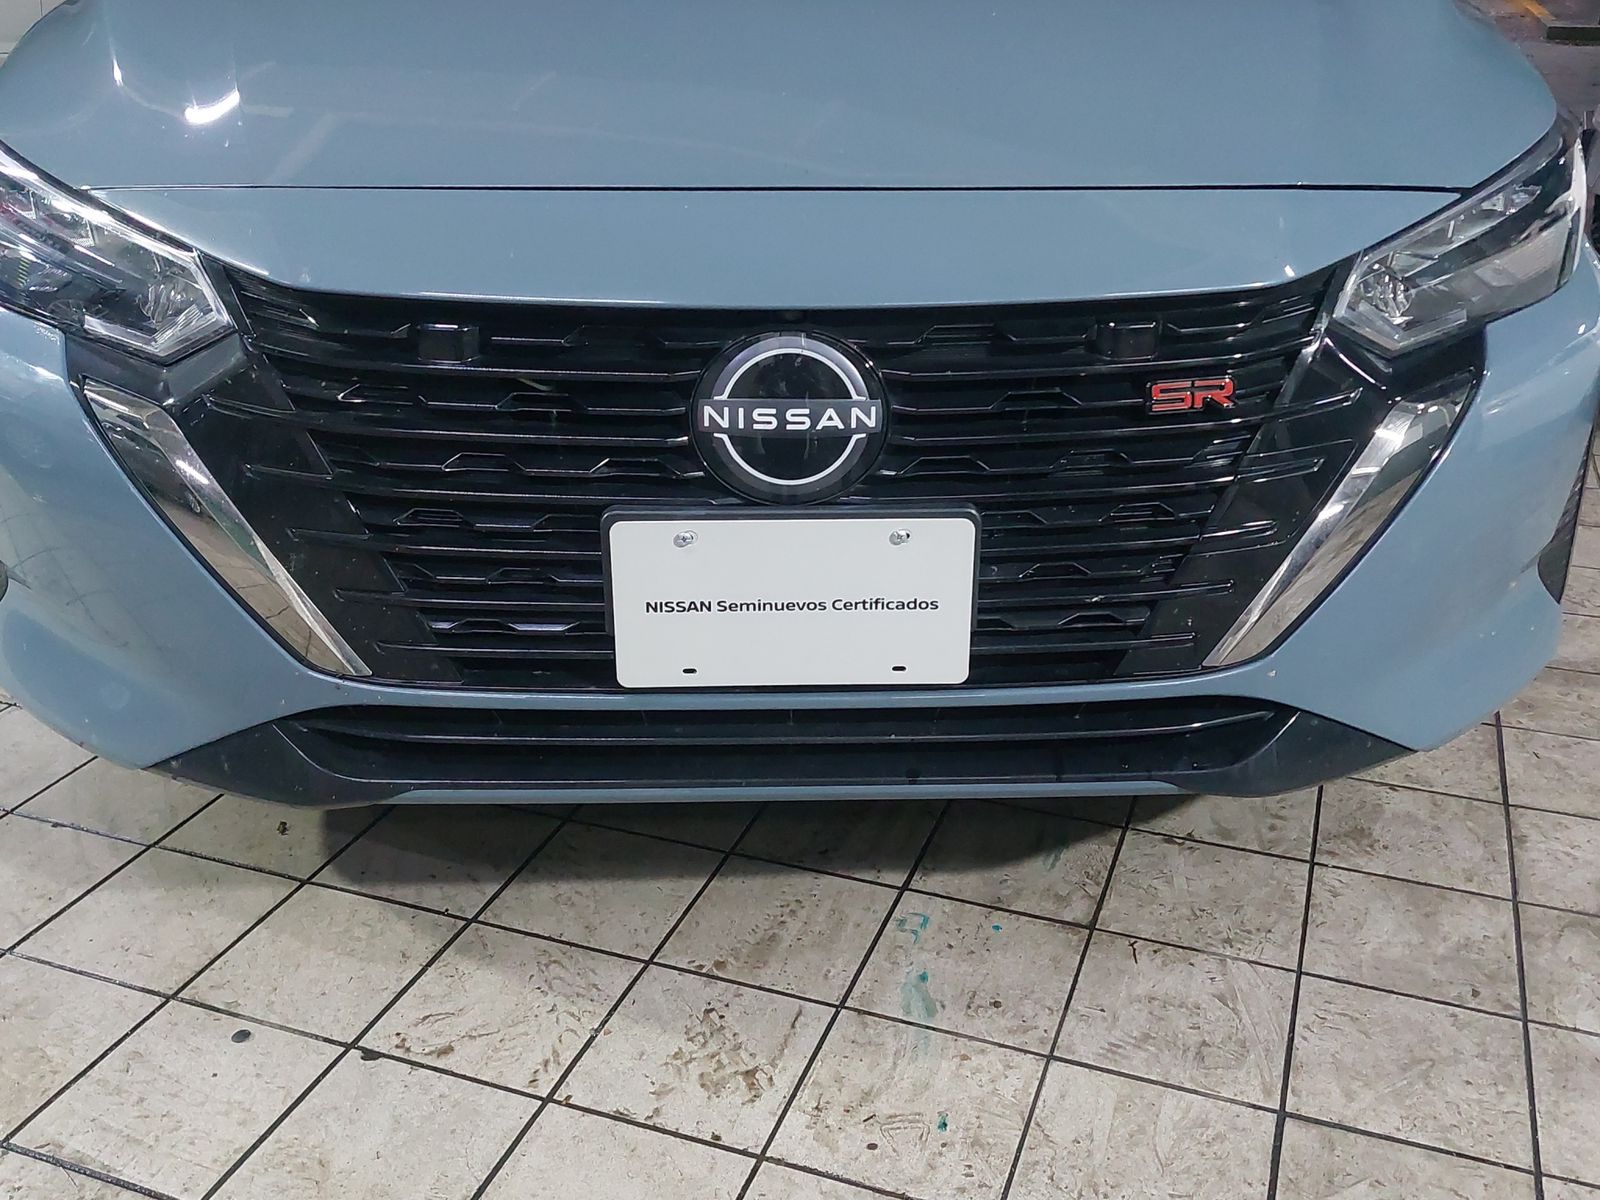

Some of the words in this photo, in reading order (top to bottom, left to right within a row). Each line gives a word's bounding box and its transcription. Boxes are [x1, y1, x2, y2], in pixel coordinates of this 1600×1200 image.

[1151, 379, 1234, 411] SR
[703, 405, 877, 430] NISSAN
[645, 600, 712, 614] NISSAN
[716, 598, 827, 613] Seminuevos
[831, 597, 939, 611] Certificados
